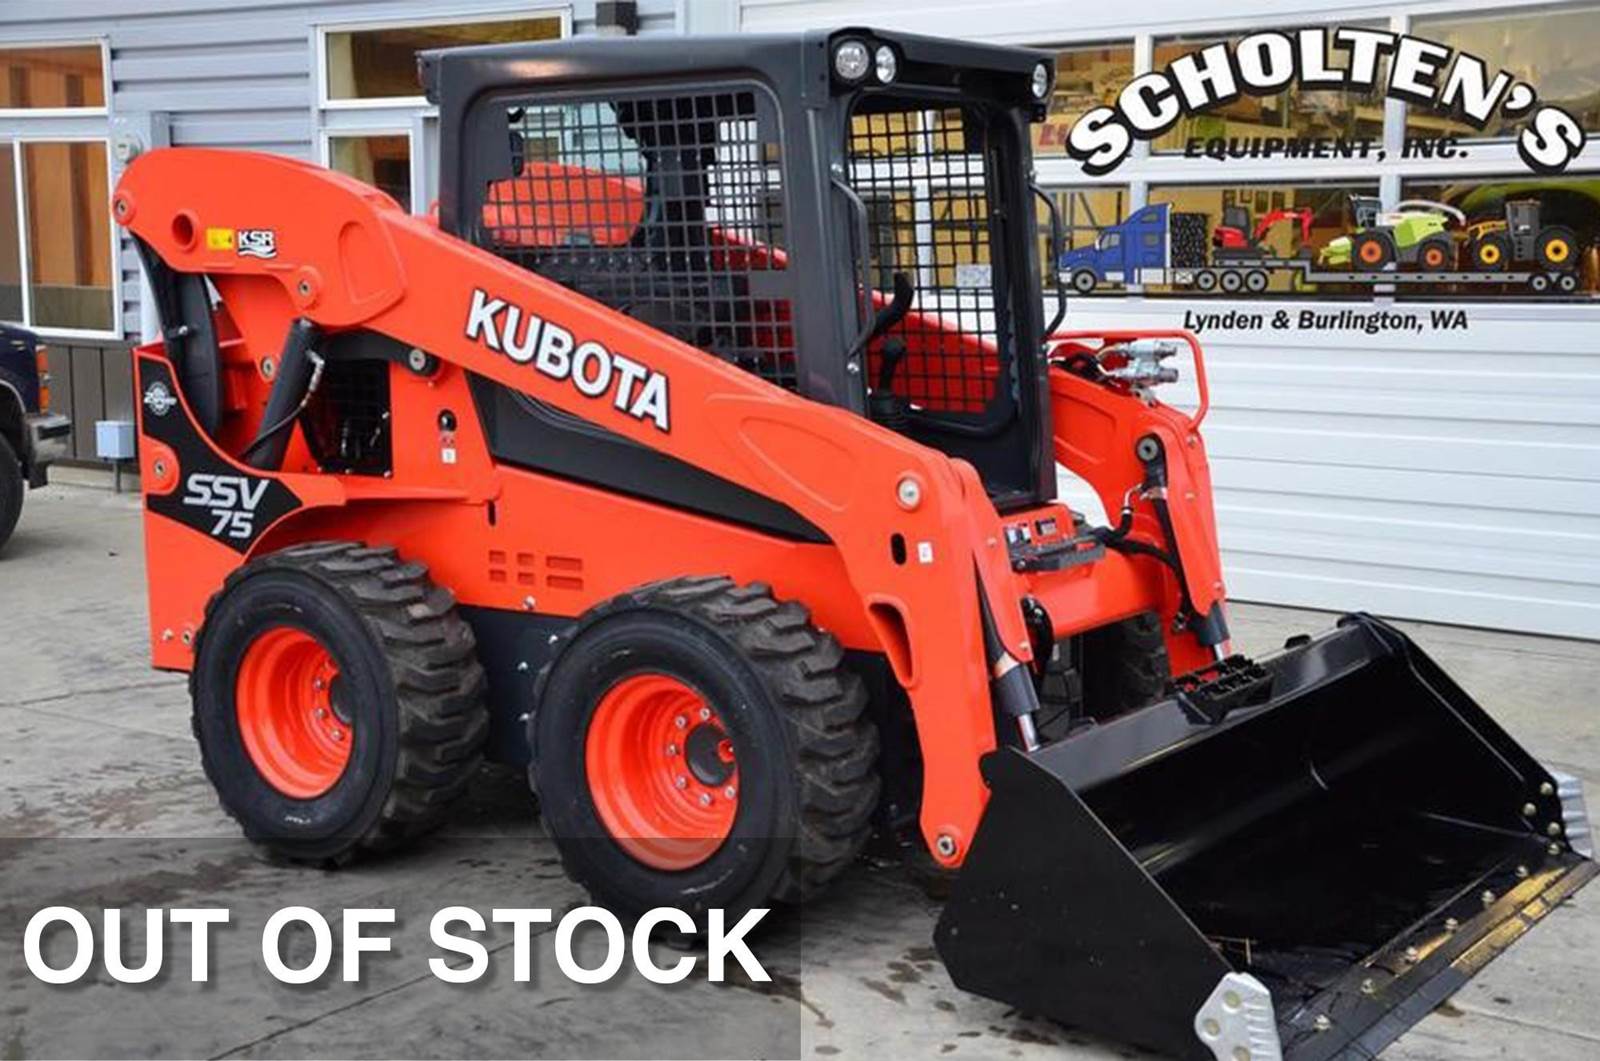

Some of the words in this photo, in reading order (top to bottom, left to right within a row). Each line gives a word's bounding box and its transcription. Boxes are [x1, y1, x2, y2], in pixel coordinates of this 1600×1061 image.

[1065, 26, 1587, 176] SCHOLTEN'S
[1184, 137, 1386, 162] EQUIPMENT,
[1401, 137, 1469, 159] INC.
[1184, 310, 1264, 334] Lynden
[1271, 310, 1291, 330] &
[1298, 310, 1424, 334] Burlington,
[1430, 310, 1469, 330] WA
[465, 288, 670, 431] KUBOTA
[182, 472, 270, 510] SSV
[210, 509, 254, 539] 75
